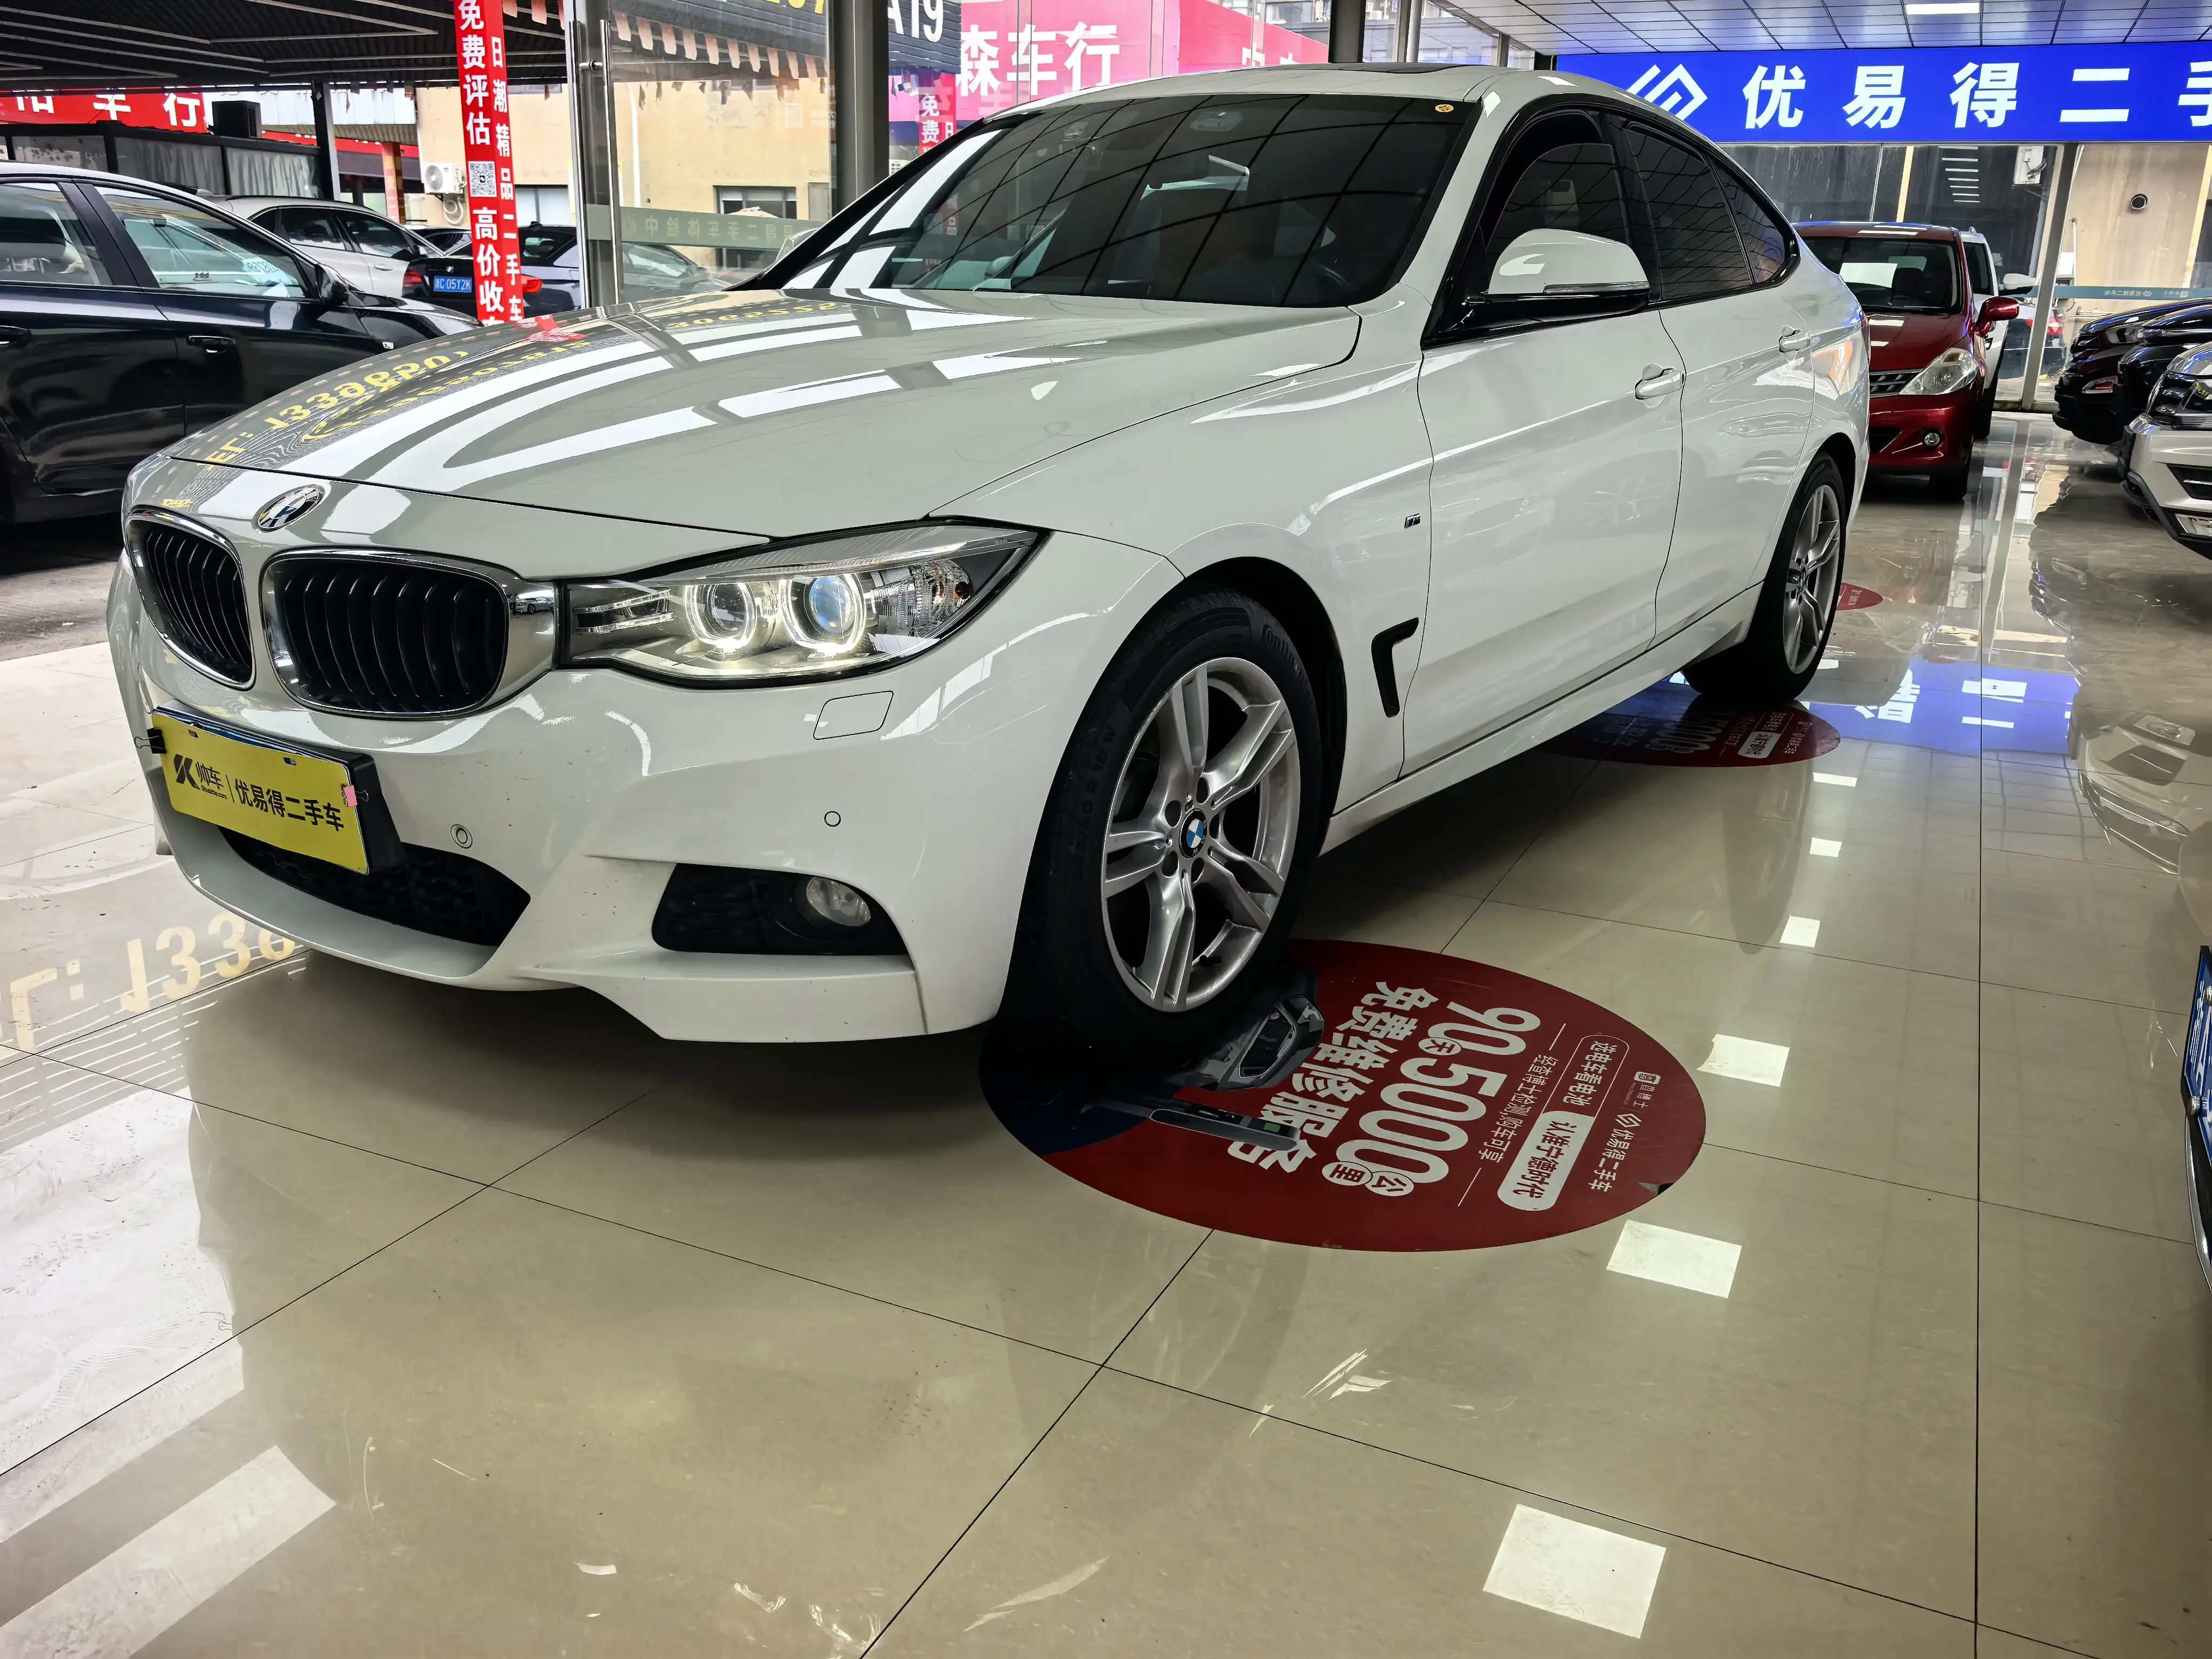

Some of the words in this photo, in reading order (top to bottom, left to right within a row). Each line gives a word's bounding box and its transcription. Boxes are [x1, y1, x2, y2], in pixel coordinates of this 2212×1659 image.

[458, 0, 490, 145] 免费评估
[491, 36, 523, 321] 日潮精品二手车
[195, 761, 224, 790] 帅车
[235, 778, 345, 832] 优易得二手车
[1227, 982, 1439, 1173] 免费维修服务
[1562, 1041, 1618, 1106] 选电车看电池
[1513, 1120, 1577, 1198] 认准宁德时代
[1588, 1128, 1635, 1192] 优易得二手车
